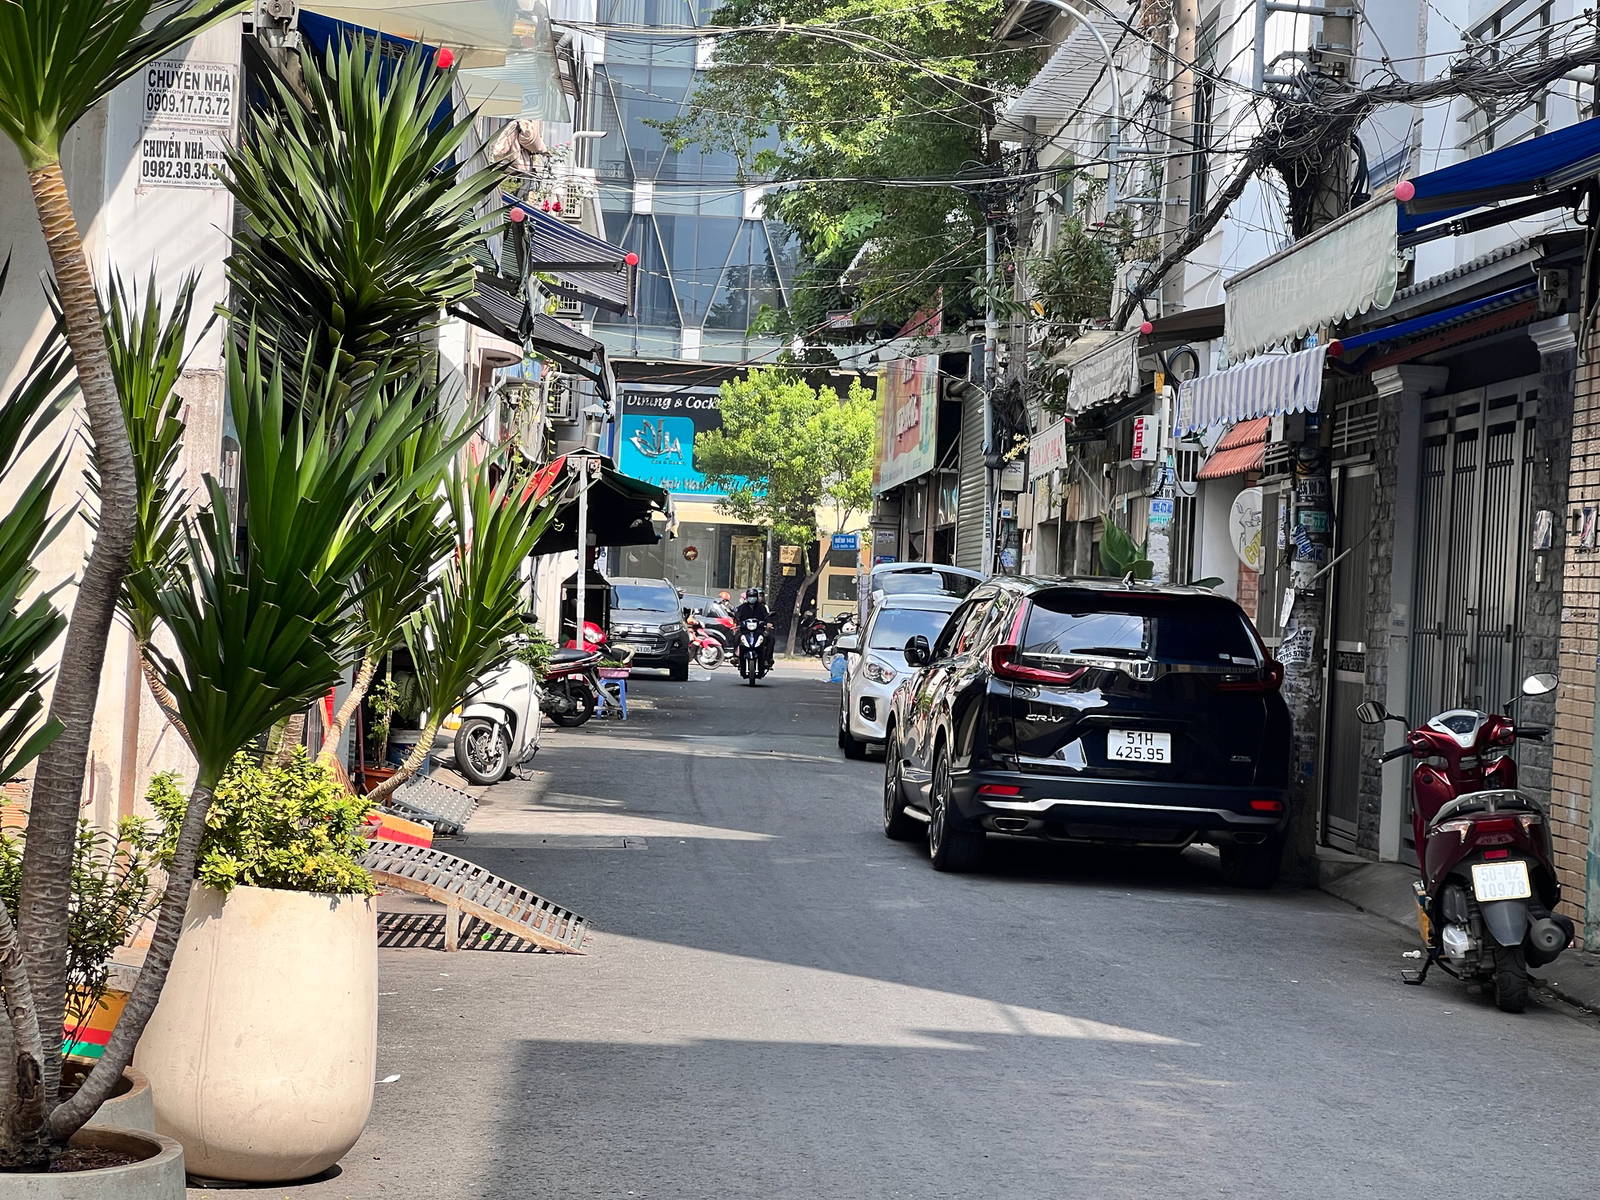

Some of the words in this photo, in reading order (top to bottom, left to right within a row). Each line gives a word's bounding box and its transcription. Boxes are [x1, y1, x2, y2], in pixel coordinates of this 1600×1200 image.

[148, 67, 201, 90] CHUYỂN
[204, 71, 231, 92] NHÀ
[147, 93, 230, 115] 0909.17.73.72
[143, 132, 181, 159] CHUYỂN
[184, 137, 204, 160] NHÀ
[626, 393, 671, 410] Dining
[674, 398, 683, 408] &
[1025, 714, 1064, 723] CR-V
[1127, 732, 1153, 746] 51H
[1116, 746, 1164, 761] 425.95
